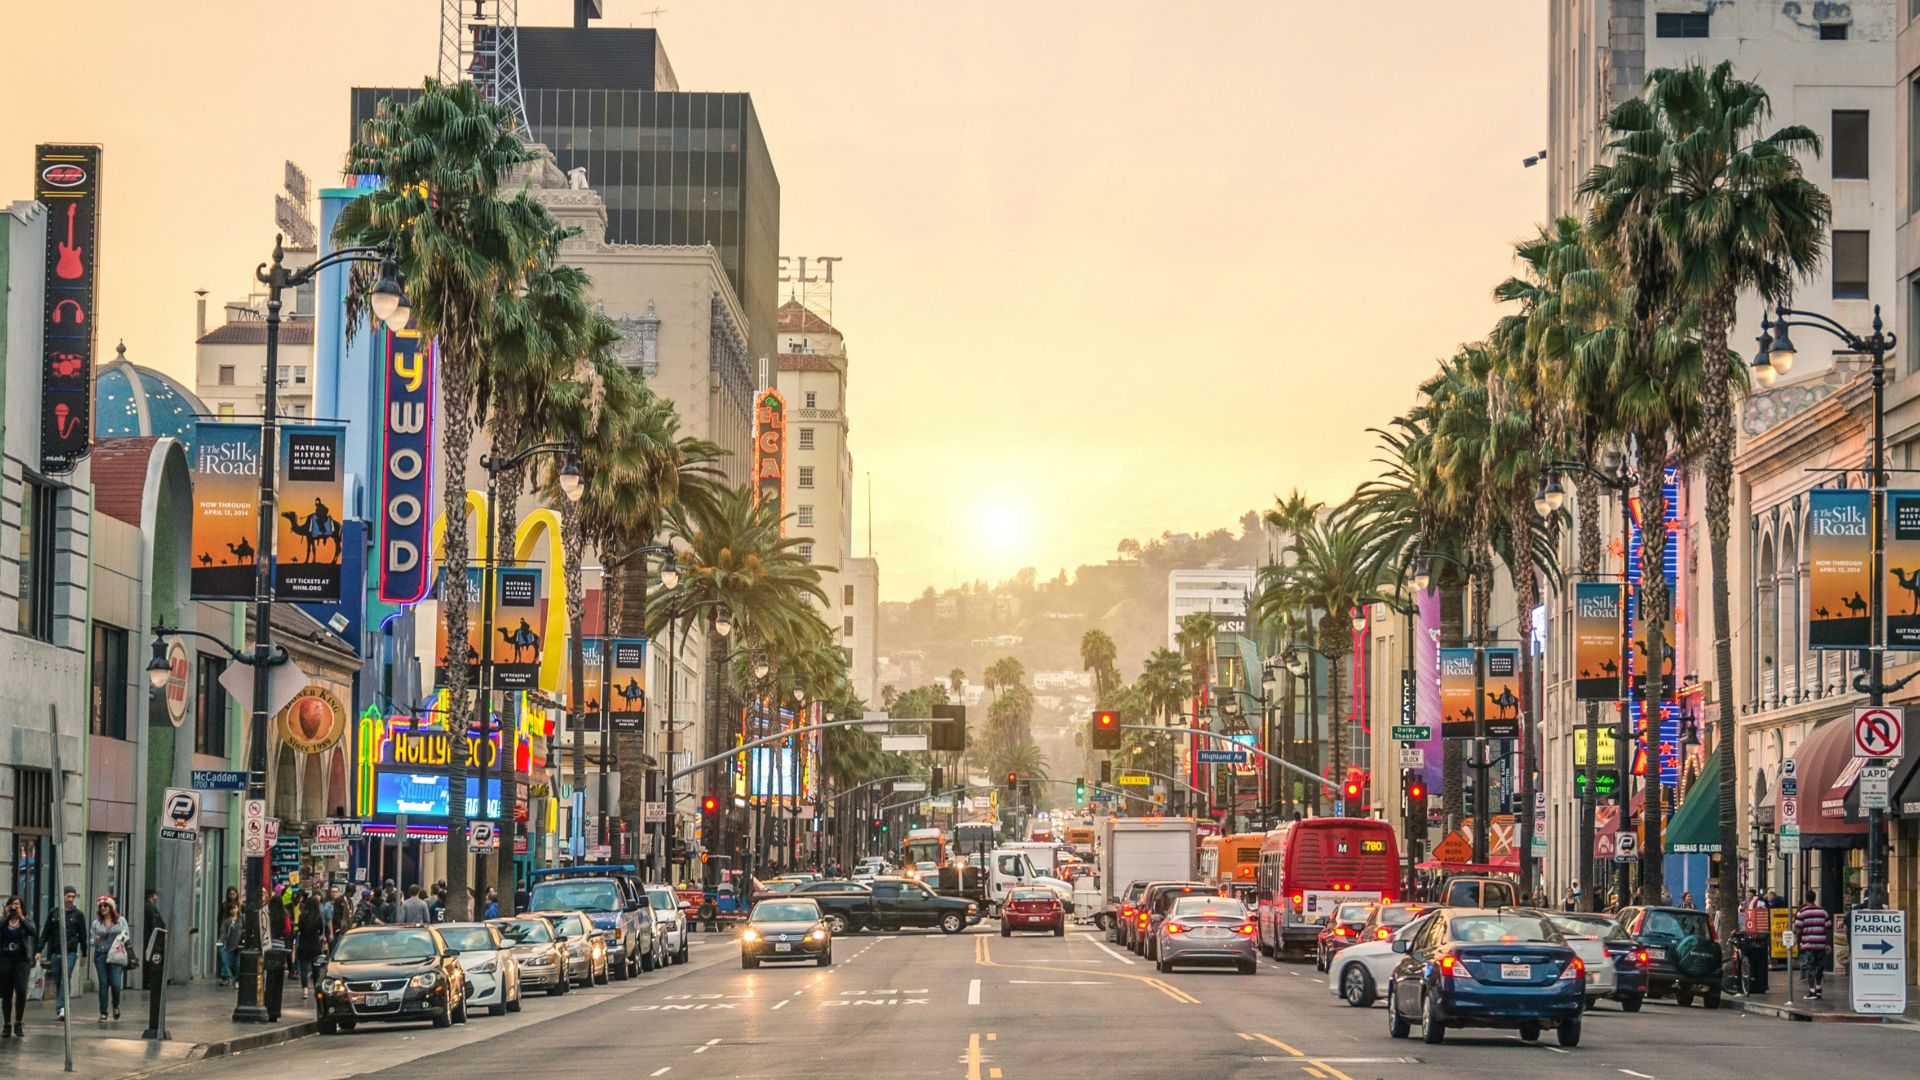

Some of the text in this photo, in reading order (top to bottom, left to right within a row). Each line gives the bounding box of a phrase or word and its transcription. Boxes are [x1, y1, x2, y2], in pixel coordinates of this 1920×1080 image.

[759, 406, 783, 428] EL
[206, 442, 252, 460] The Silk
[294, 444, 330, 452] NATURAL
[206, 454, 256, 475] Road
[1820, 506, 1862, 522] The Silk
[1820, 517, 1866, 536] Road
[1593, 596, 1614, 608] Silk
[1584, 604, 1618, 618] Road
[1454, 658, 1470, 668] Silk
[1447, 664, 1473, 675] Road
[320, 690, 340, 713] KING
[288, 736, 332, 752] Since 1989
[194, 772, 237, 782] McCadden
[1862, 770, 1886, 778] LAPD
[178, 832, 195, 840] HERE
[320, 828, 340, 837] ATM
[1338, 844, 1347, 853] M
[1364, 841, 1383, 851] 780
[1674, 844, 1697, 852] CAMERAS
[1854, 915, 1901, 923] PUBLIC
[1854, 925, 1902, 933] PARKING
[1858, 962, 1870, 970] PARK
[1872, 962, 1884, 970] LOCK
